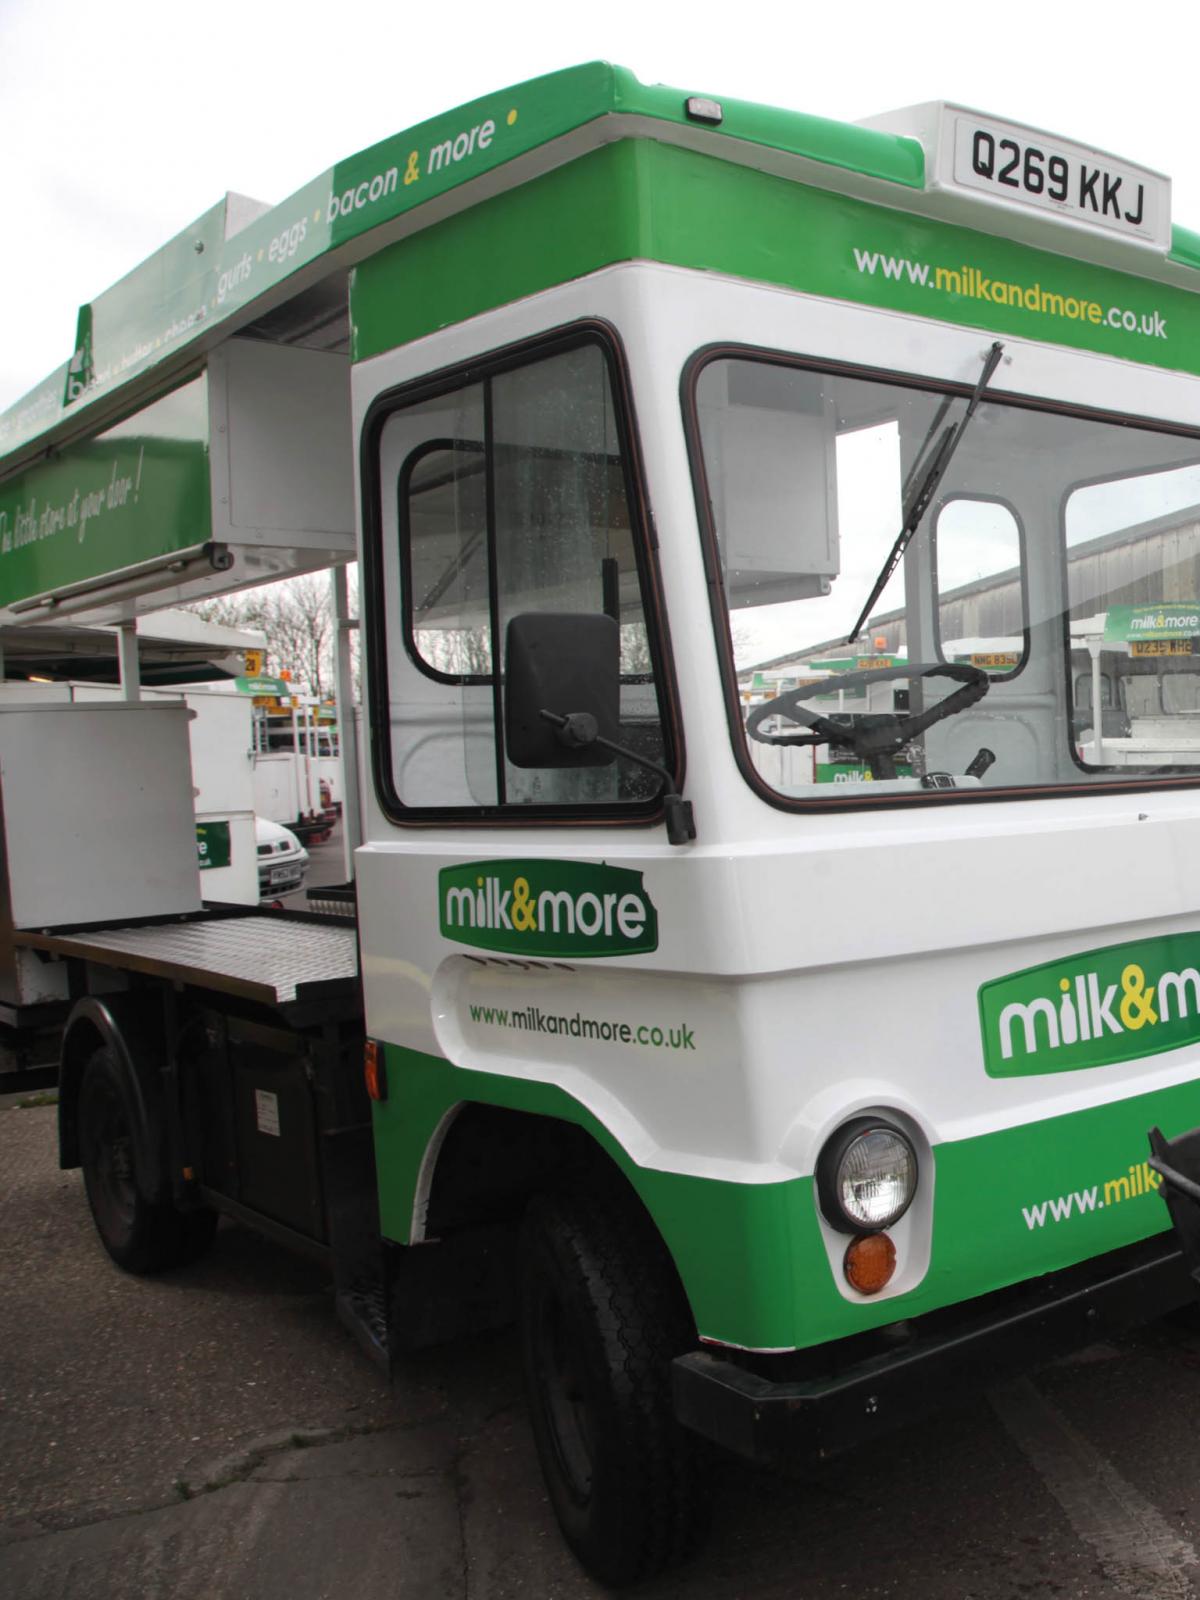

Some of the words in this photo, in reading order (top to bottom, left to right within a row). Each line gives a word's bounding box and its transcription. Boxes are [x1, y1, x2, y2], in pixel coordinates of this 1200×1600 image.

[268, 217, 307, 264] eggs
[326, 167, 398, 225] bacon
[403, 151, 421, 186] &
[427, 119, 496, 175] more
[972, 130, 1068, 202] Q269
[1079, 164, 1144, 226] KKJ
[853, 247, 1168, 339] www.milkandmore.co.uk
[1130, 613, 1199, 631] milk&more
[446, 876, 647, 940] milk&more
[469, 1003, 697, 1050] www.milkandmore.co.uk
